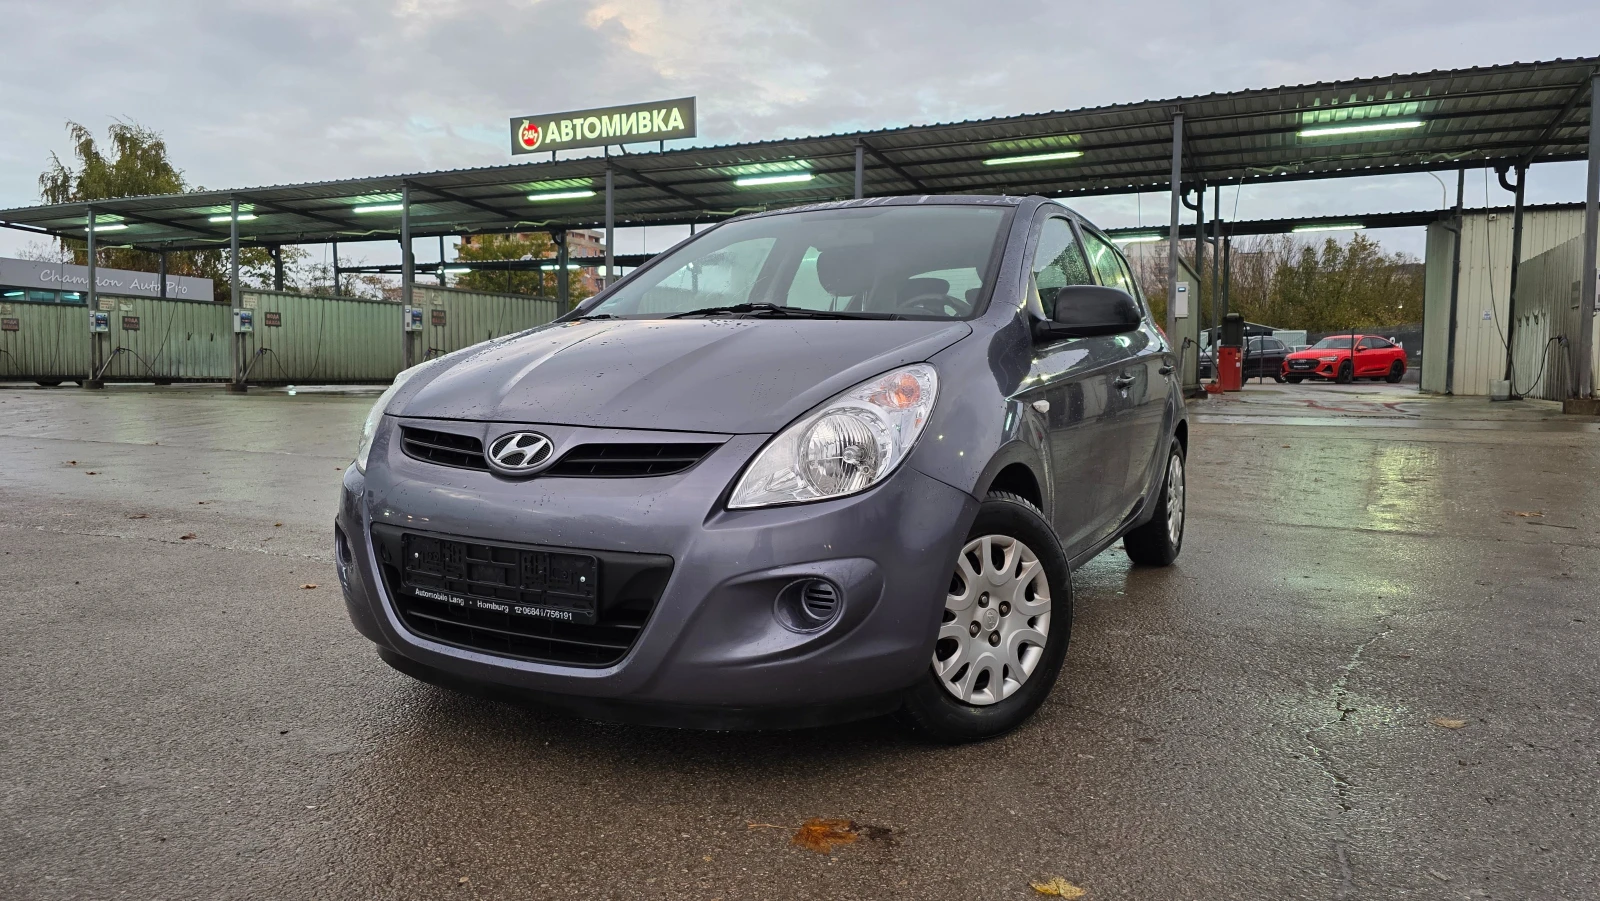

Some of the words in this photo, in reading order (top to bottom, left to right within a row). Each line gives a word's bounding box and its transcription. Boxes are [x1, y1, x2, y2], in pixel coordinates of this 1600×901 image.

[545, 107, 685, 143] АВТОМИВКА
[129, 278, 160, 292] Auto
[166, 281, 188, 294] Pro
[415, 588, 448, 602] Automobile
[449, 595, 465, 606] Lang
[477, 600, 509, 613] Homburg
[522, 606, 572, 620] 06841/756191
